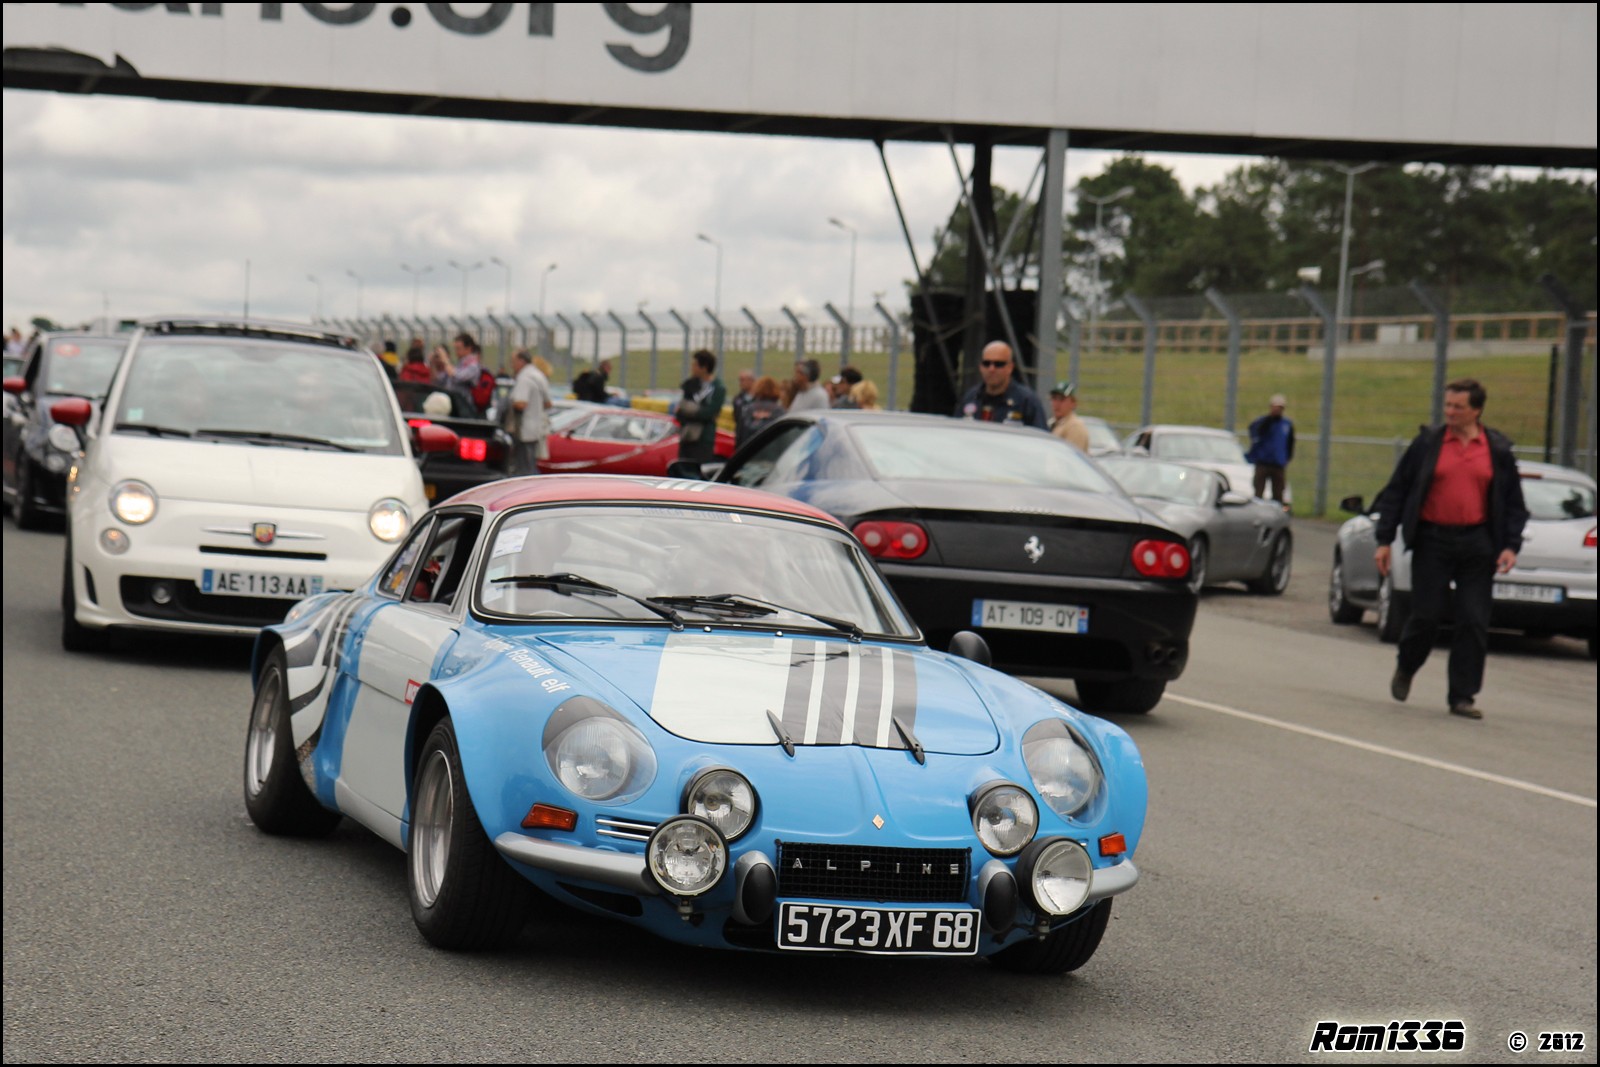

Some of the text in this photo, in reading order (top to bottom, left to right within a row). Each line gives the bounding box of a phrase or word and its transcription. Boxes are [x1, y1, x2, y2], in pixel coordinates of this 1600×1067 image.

[505, 648, 572, 694] Renault elf
[792, 857, 960, 876] ALPINE
